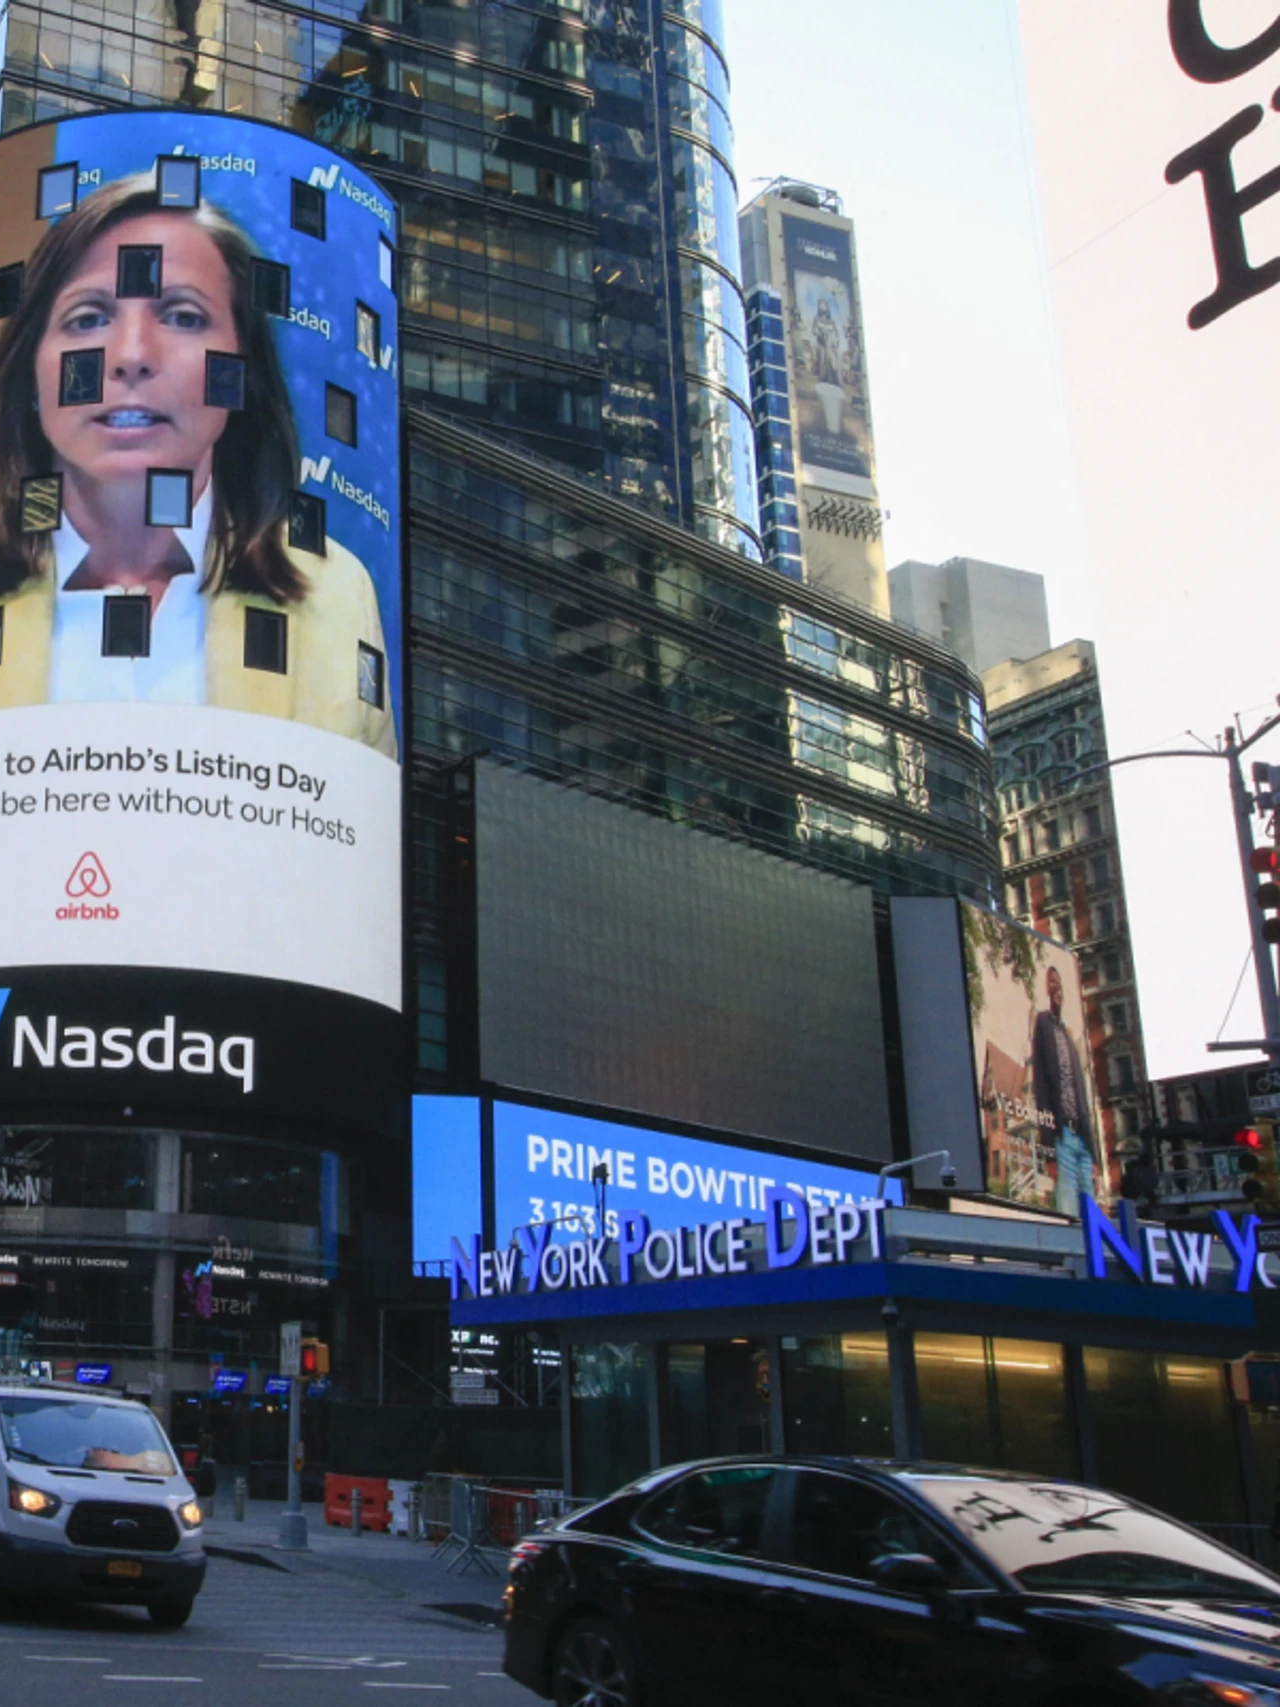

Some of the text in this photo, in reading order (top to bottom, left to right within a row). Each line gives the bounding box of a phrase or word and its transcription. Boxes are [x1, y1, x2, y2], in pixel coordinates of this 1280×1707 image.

[200, 153, 256, 177] asdaq
[339, 176, 392, 231] Nasdaq
[287, 306, 331, 340] sdaq
[331, 470, 390, 532] Nasdaq
[4, 752, 35, 775] to
[176, 749, 272, 791] Listing
[277, 762, 327, 802] Day
[1, 790, 37, 816] be
[45, 787, 111, 812] here
[119, 787, 235, 821] without
[241, 802, 286, 827] our
[291, 807, 357, 846] Hosts
[55, 902, 120, 921] airbnb
[12, 1014, 255, 1094] Nasdaq
[527, 1134, 637, 1190] PRIME
[451, 1187, 888, 1300] NEW YORK POLICE DEPT
[1081, 1191, 1213, 1288] NEW
[212, 1264, 245, 1279] Nasdaq
